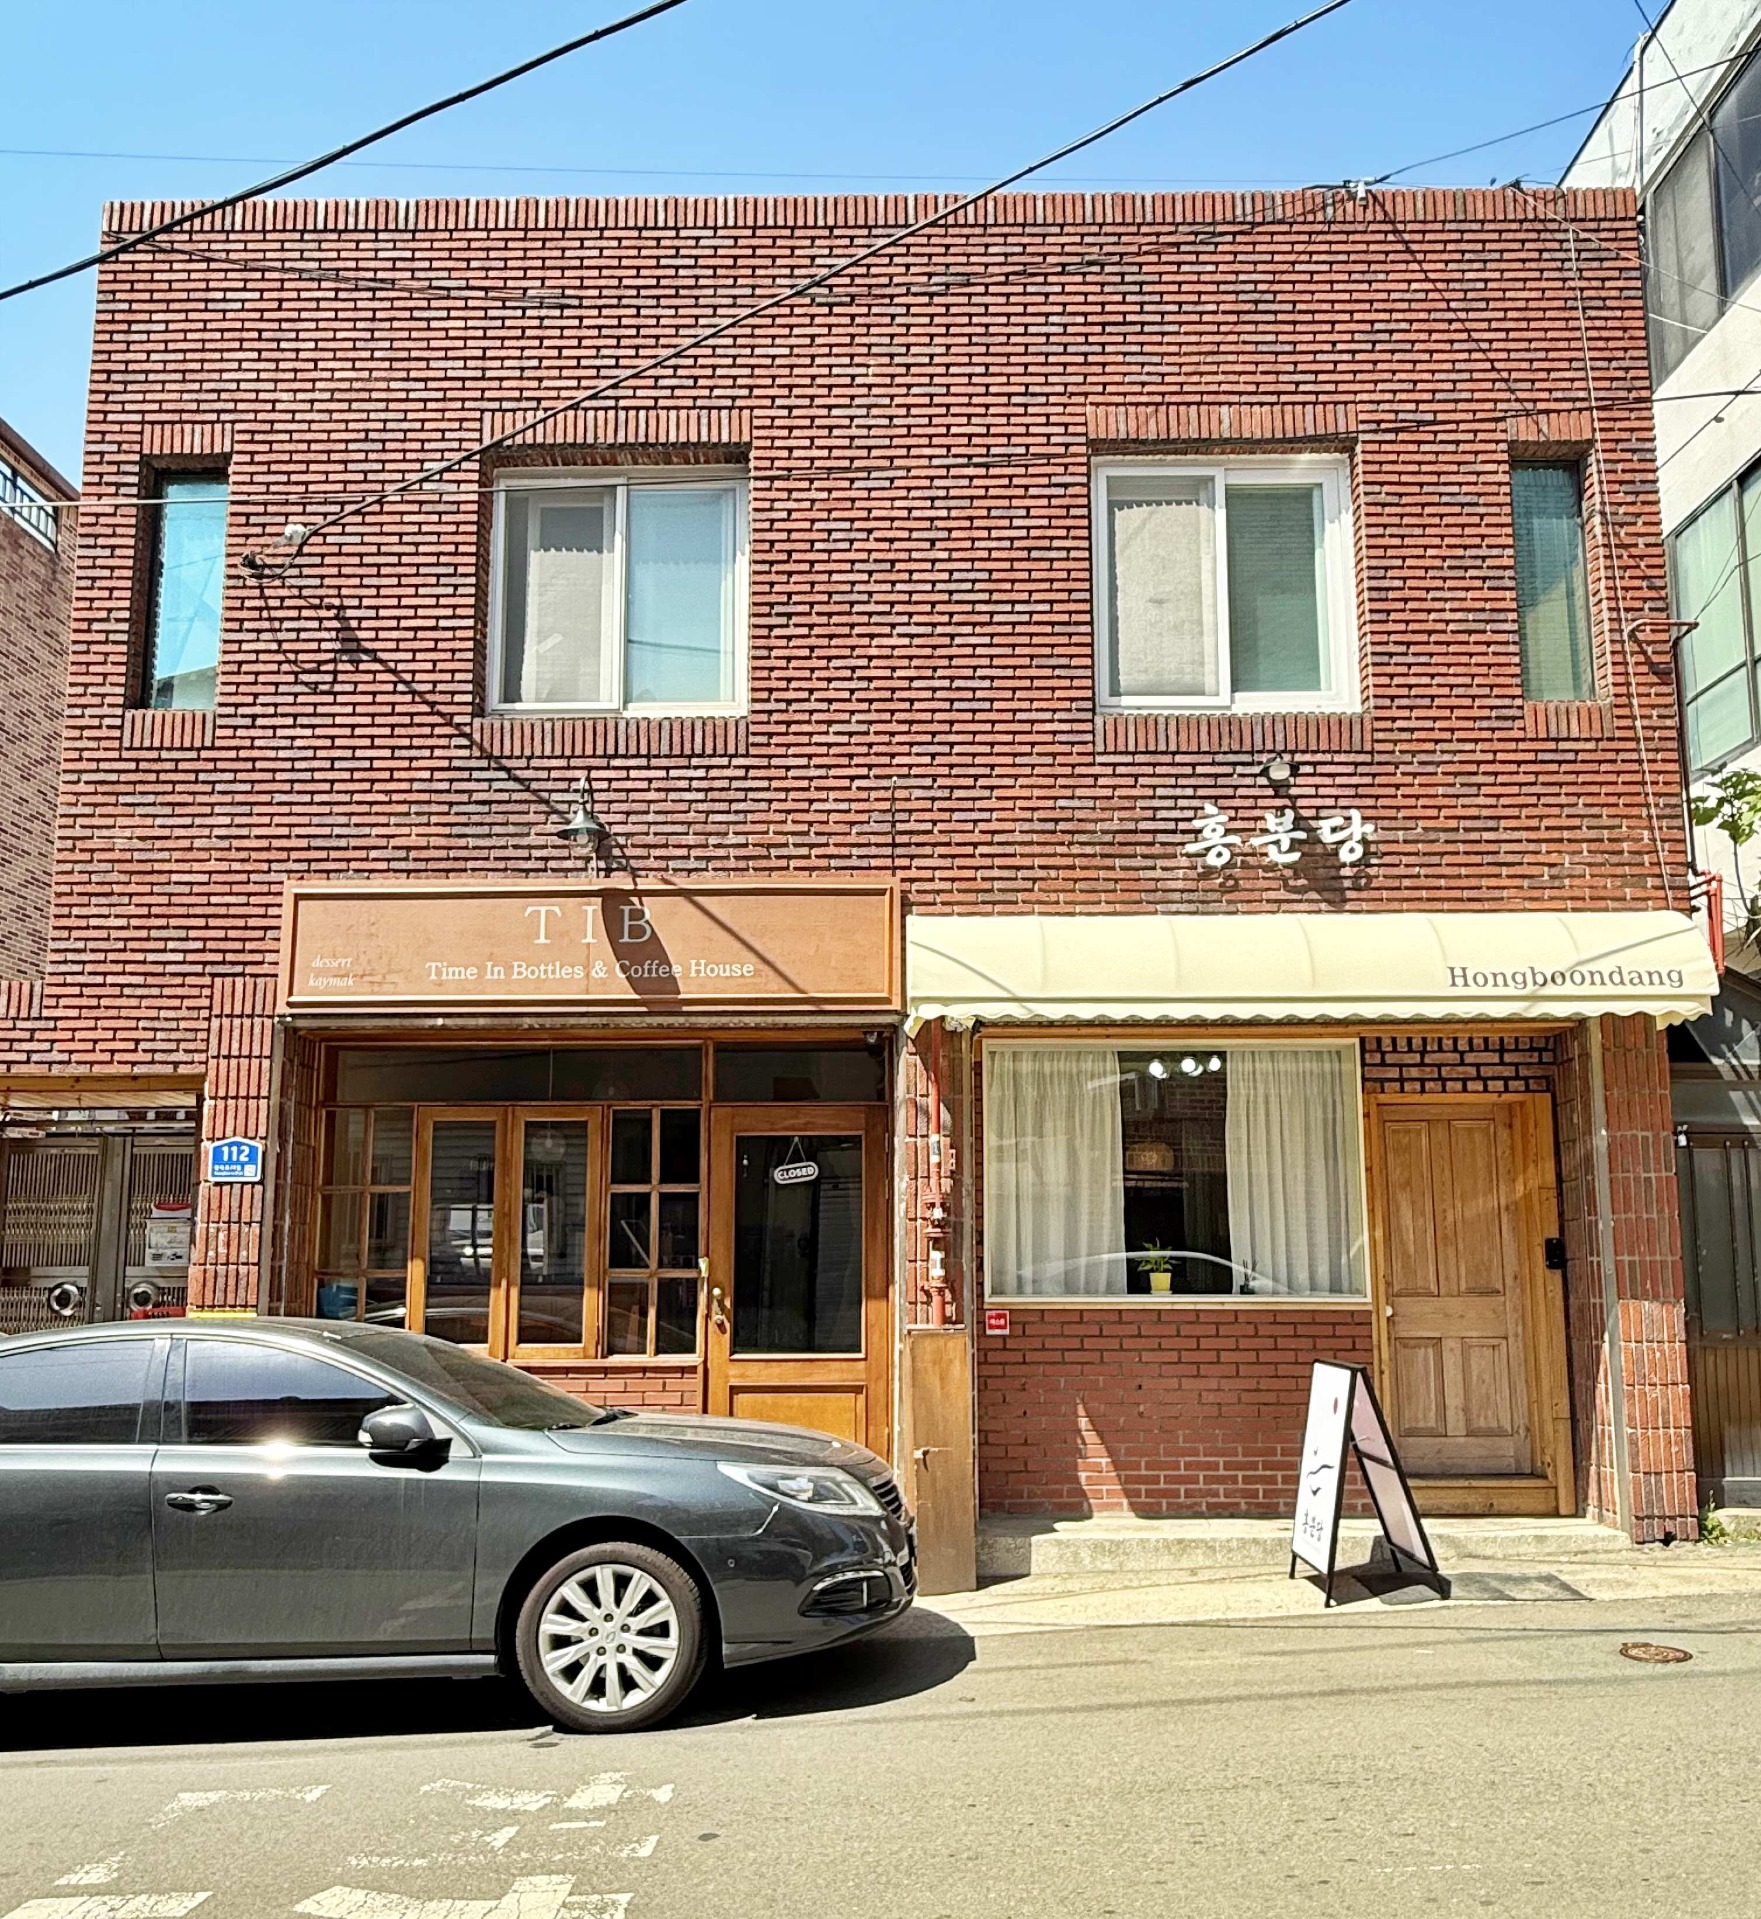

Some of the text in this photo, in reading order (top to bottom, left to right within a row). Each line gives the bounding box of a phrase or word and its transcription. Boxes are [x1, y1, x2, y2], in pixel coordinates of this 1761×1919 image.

[1183, 804, 1375, 866] 홍분당
[312, 954, 351, 969] dessert
[425, 959, 754, 981] Time In Bottles & Coffee House
[309, 973, 354, 988] kaymak
[1448, 965, 1684, 990] Hongboondang
[221, 1145, 250, 1162] 112
[778, 1166, 815, 1179] CLOSED
